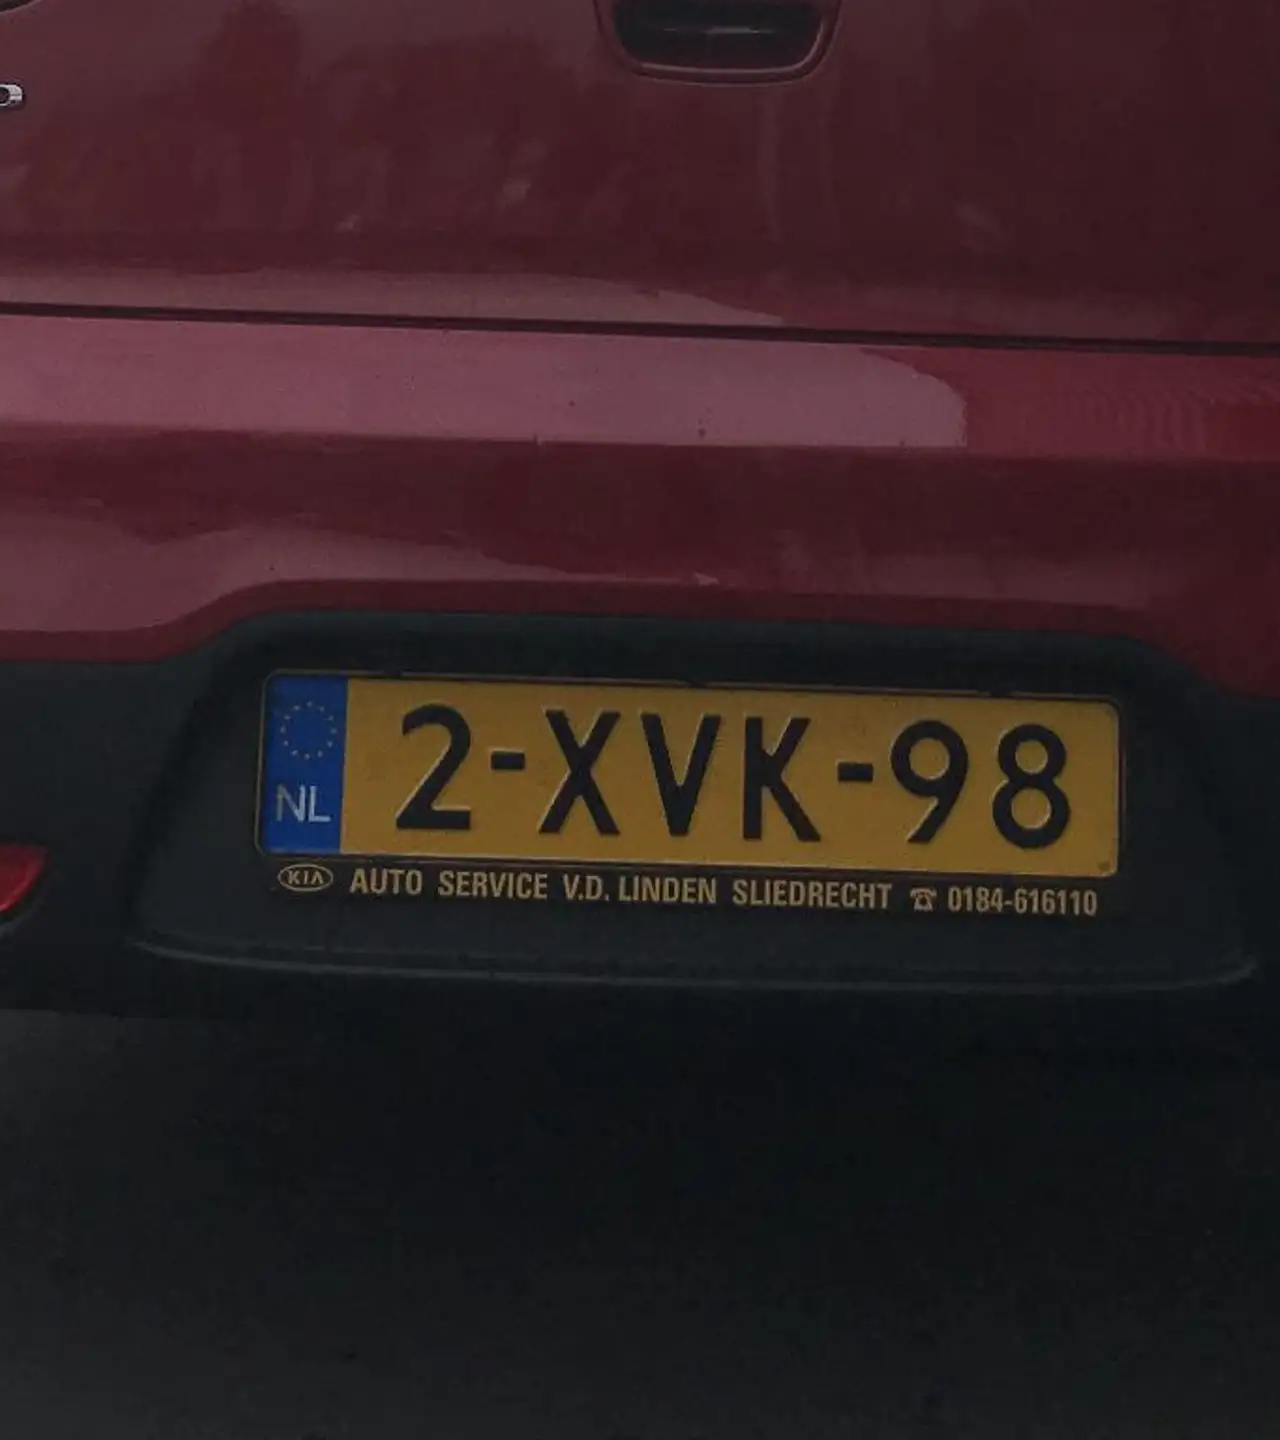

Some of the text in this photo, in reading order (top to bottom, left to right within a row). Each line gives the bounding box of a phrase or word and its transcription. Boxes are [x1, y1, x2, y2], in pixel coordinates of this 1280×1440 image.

[275, 703, 1072, 850] NL 2-XVK-98
[287, 867, 1098, 917] KIA AUTO SERVICE V.D. LINDEN SLIEDRECHT 0184-616110
